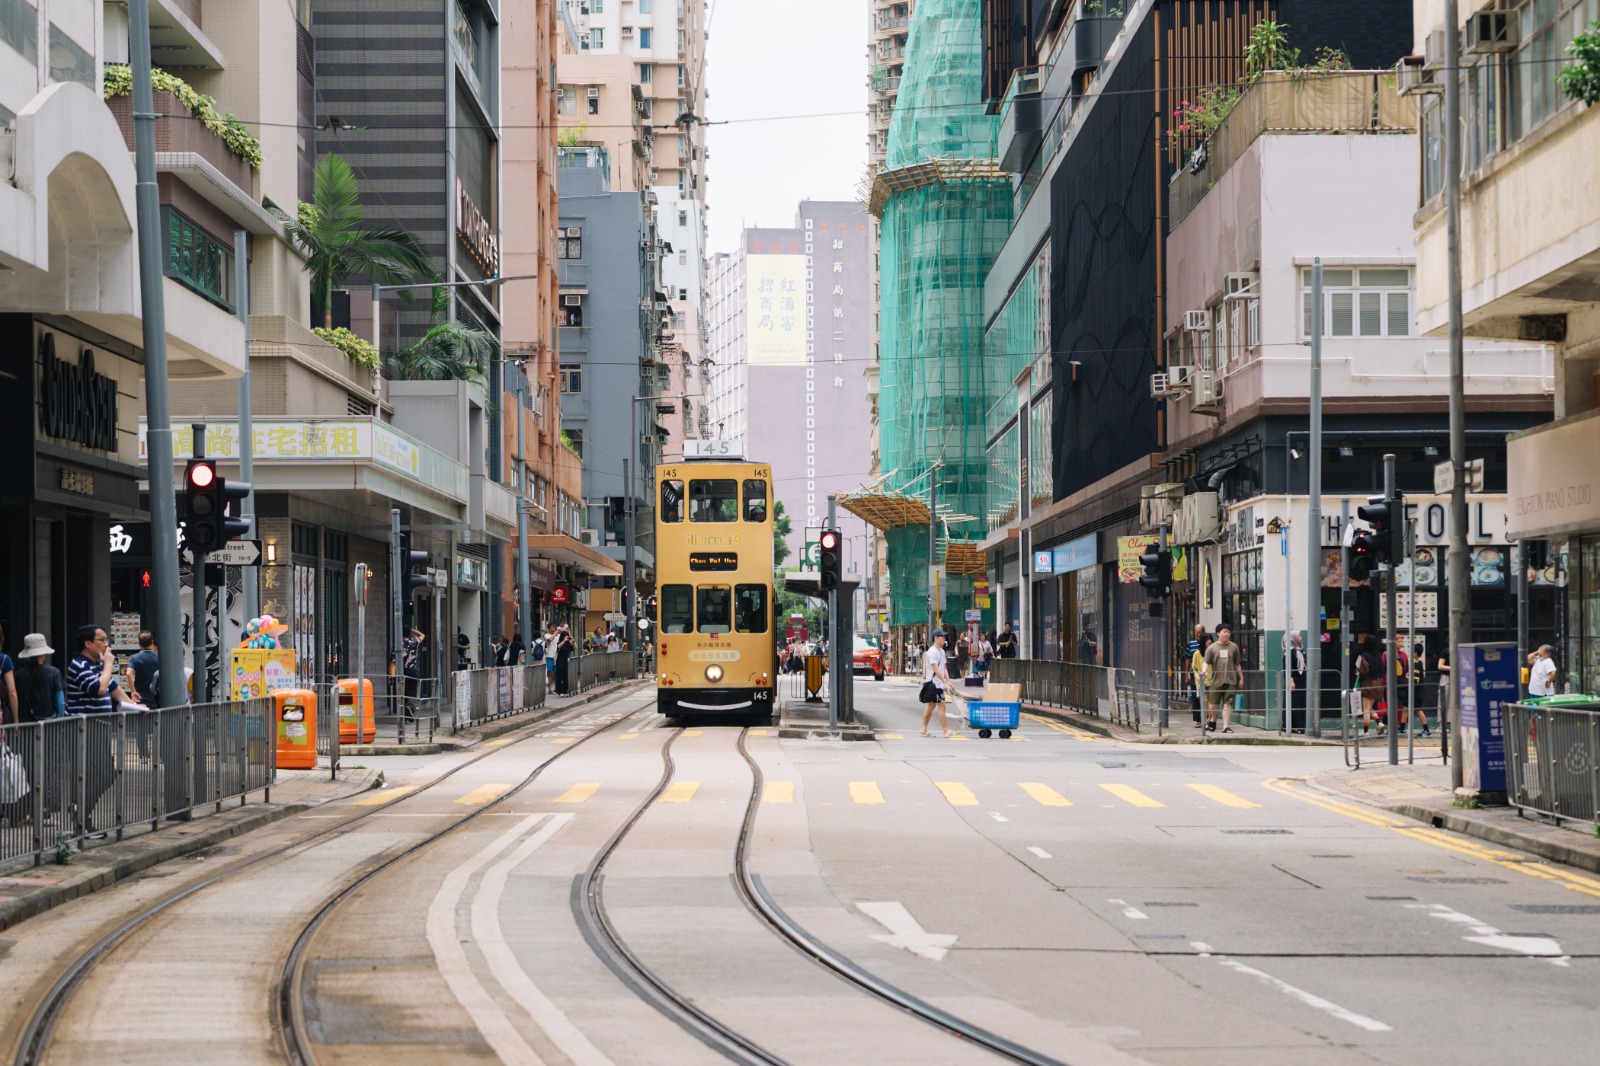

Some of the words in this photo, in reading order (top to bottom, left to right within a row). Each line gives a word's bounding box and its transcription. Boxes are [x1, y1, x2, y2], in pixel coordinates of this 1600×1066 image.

[757, 278, 774, 331] 招商局
[696, 441, 729, 455] 145
[663, 469, 677, 478] 145
[754, 469, 768, 478] 145
[1545, 488, 1565, 511] PIANO
[1567, 483, 1592, 507] STUDIO
[212, 553, 232, 562] 北街
[753, 691, 768, 700] 145
